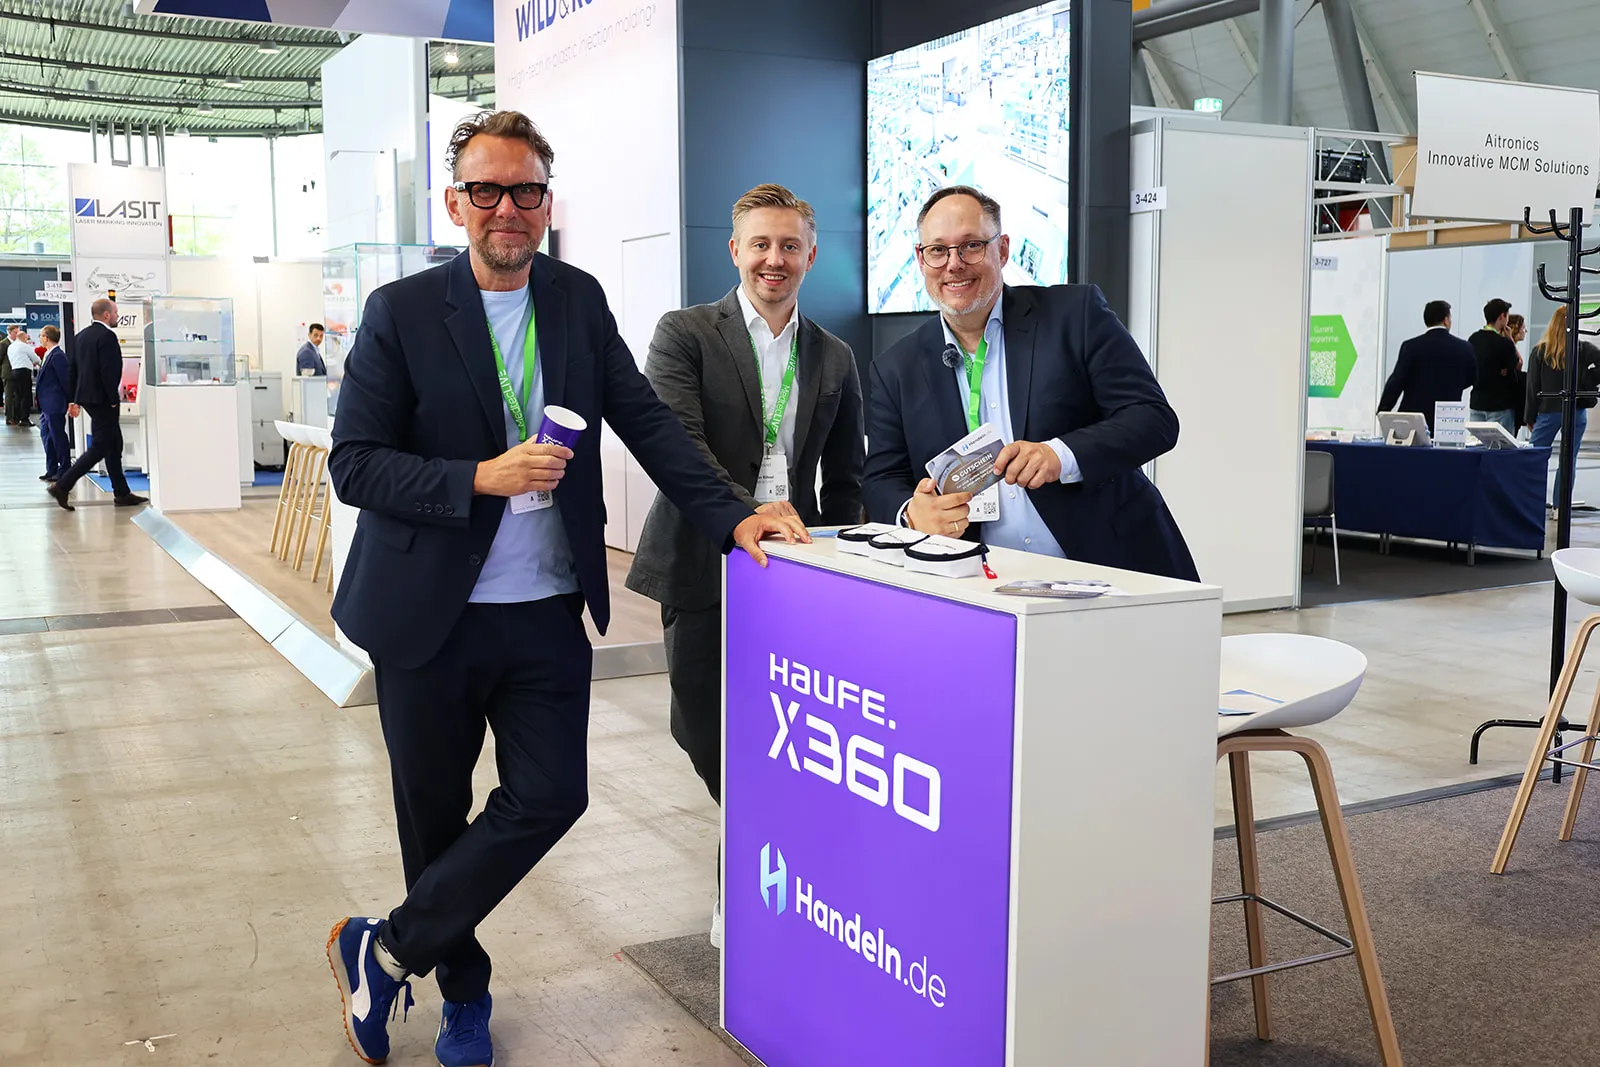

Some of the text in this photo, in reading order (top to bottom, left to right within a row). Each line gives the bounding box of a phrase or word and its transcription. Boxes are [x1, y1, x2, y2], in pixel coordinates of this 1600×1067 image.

[516, 0, 592, 42] WILD&
[1485, 134, 1540, 151] Aitronics
[1428, 150, 1589, 176] Innovative MCM Solutions
[96, 199, 160, 219] LASIT
[1136, 193, 1157, 204] 3-424
[1315, 258, 1331, 266] 3-727
[117, 315, 137, 326] ASIT
[1310, 336, 1339, 344] rogramme
[499, 369, 524, 427] MedtecLIVE
[960, 453, 993, 477] GUTSCHEIN
[768, 691, 941, 832] X360
[795, 876, 946, 1008] Handeln.de
